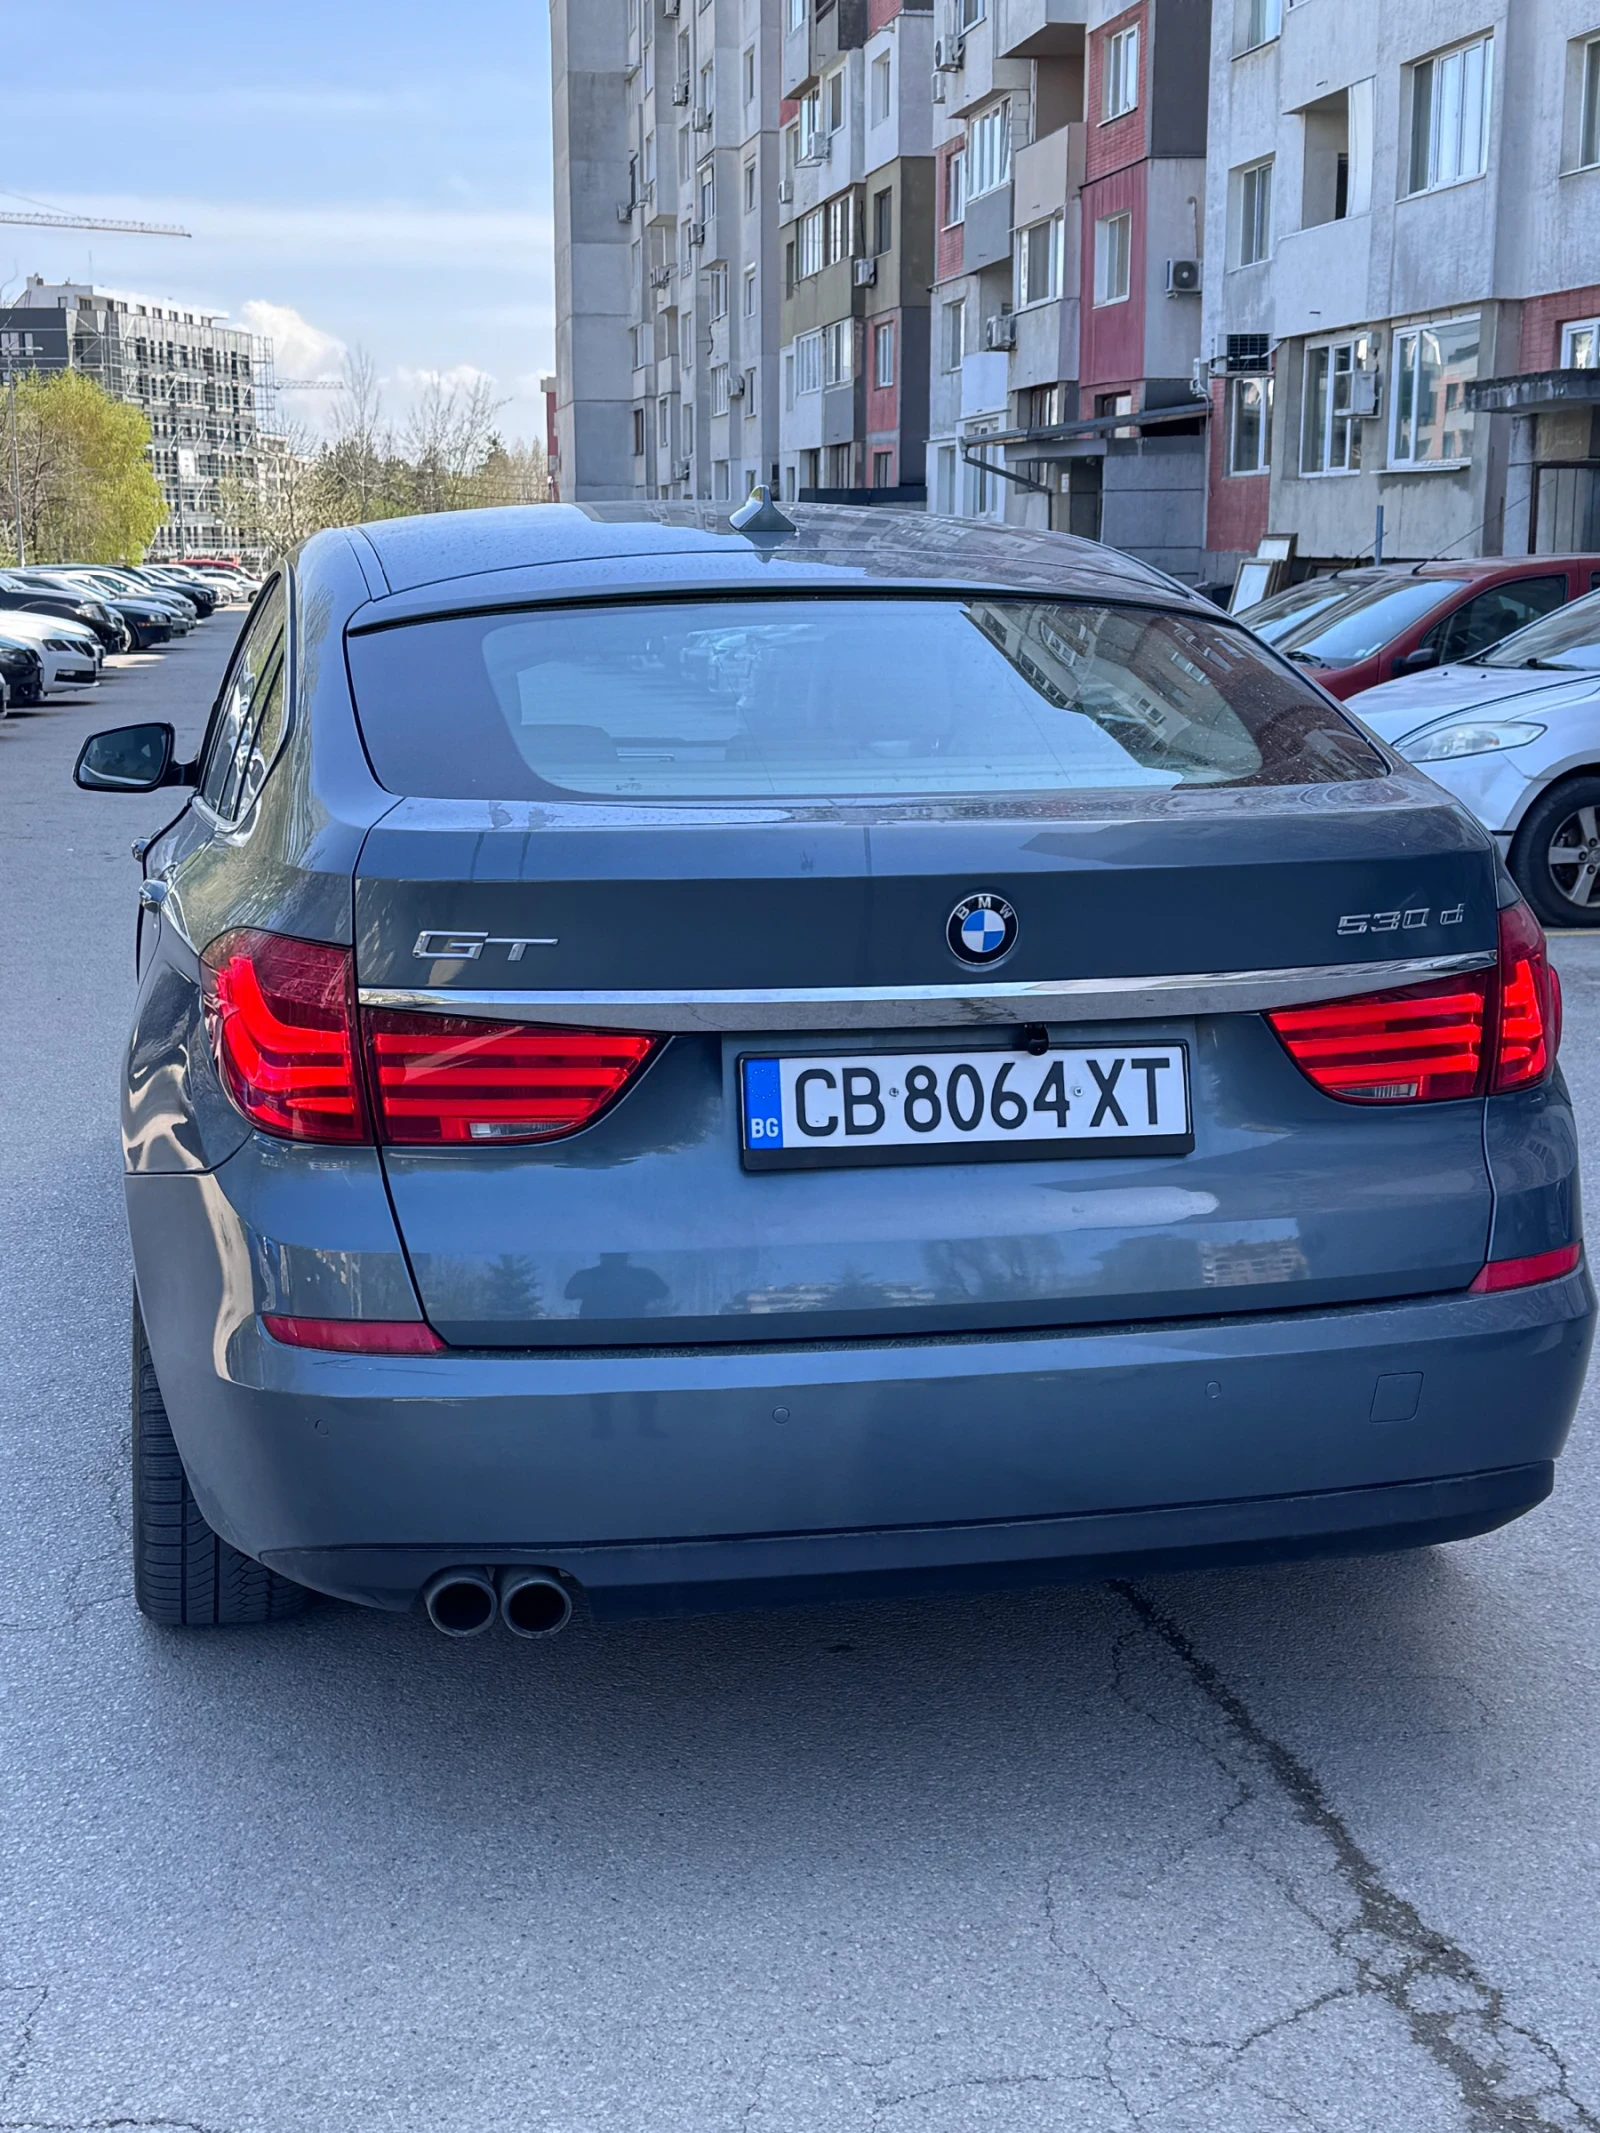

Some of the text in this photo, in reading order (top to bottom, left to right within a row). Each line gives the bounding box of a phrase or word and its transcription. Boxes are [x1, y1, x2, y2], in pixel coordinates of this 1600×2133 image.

[955, 896, 1013, 920] BMW
[1336, 907, 1430, 936] 530
[412, 930, 559, 962] GT
[794, 1057, 1171, 1137] CB 8064 XT
[751, 1117, 779, 1139] BG
